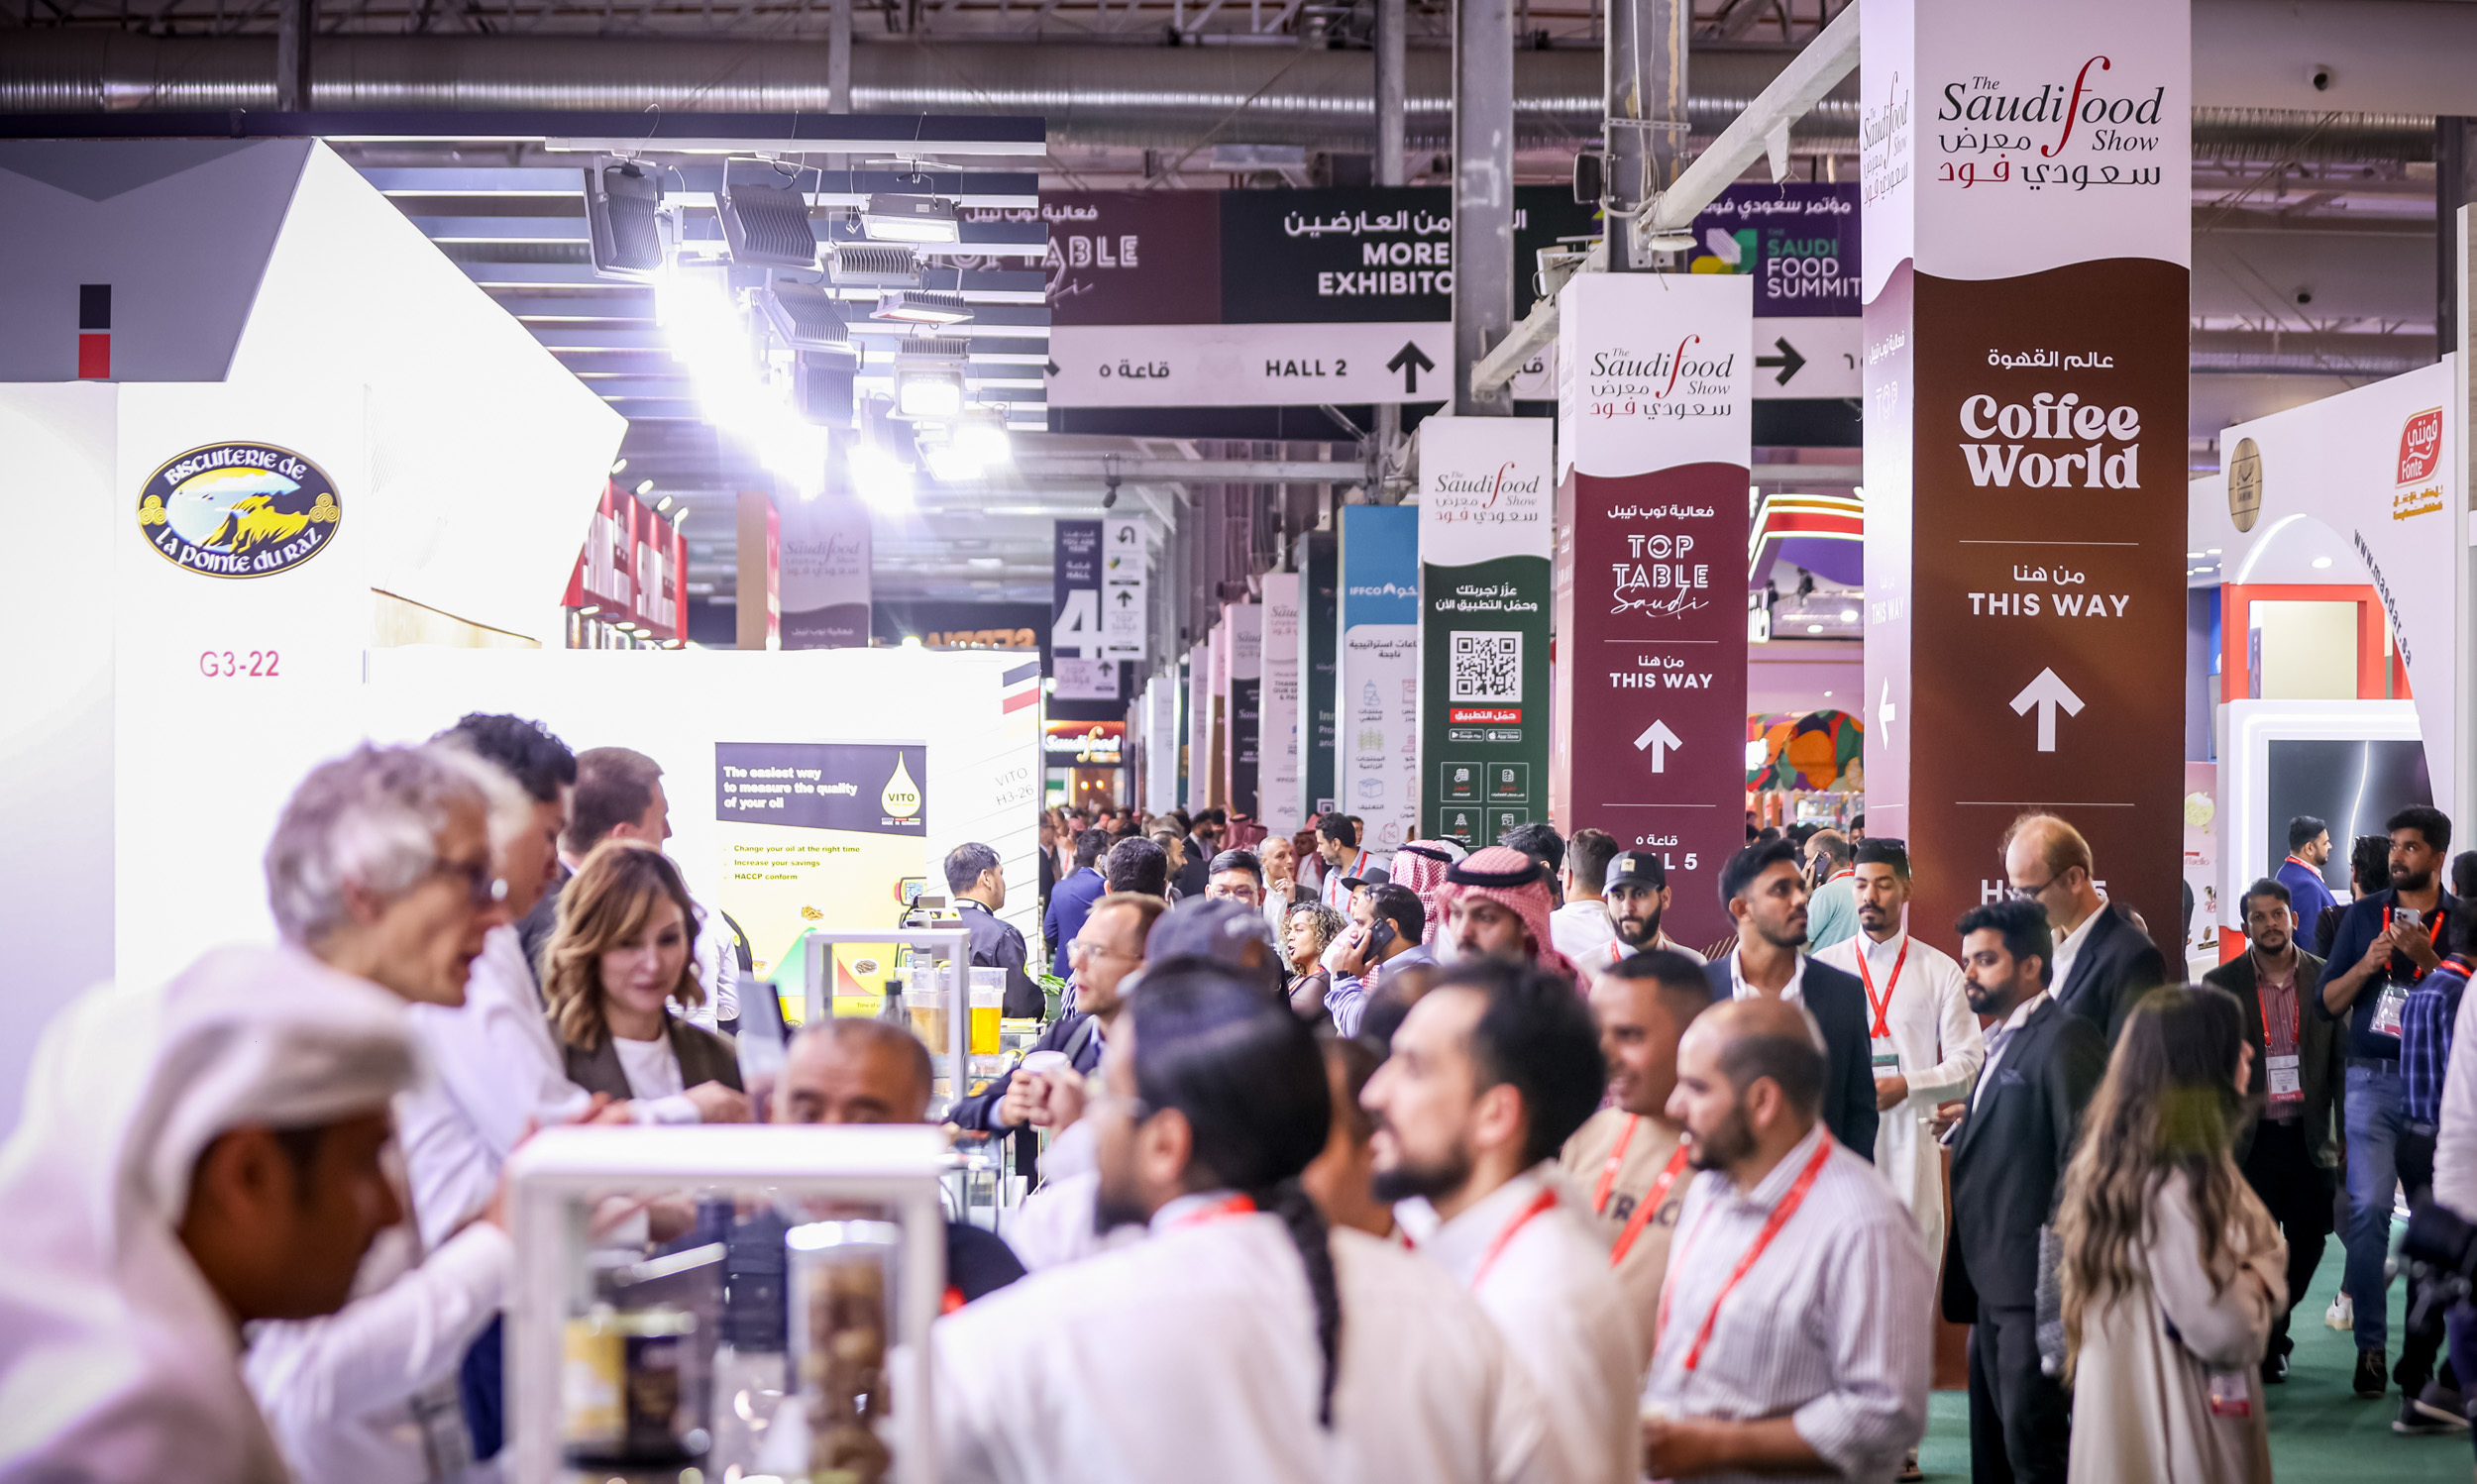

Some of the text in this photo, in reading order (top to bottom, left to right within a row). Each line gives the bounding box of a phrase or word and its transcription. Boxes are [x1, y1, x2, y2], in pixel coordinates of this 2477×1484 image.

[1973, 76, 2000, 91] The
[1938, 127, 2031, 155] معرض
[2092, 129, 2160, 152] Show
[1938, 153, 2161, 191] سعودي فود
[1042, 203, 1099, 223] فعالية
[1737, 200, 1802, 220] سعودي
[1804, 197, 1852, 216] مؤتمر
[1284, 209, 1453, 238] من العارضين
[1362, 242, 1451, 266] MORE
[1768, 238, 1838, 257] SAUDI
[1768, 257, 1840, 278] FOOD
[1318, 270, 1454, 296] EXHIBITO
[1767, 276, 1862, 298] SUMMIT
[1612, 348, 1630, 357] The
[1988, 349, 2114, 371] عالم القهوة
[1119, 360, 1170, 379] قاعة
[1266, 360, 1347, 377] HALL 2
[1590, 379, 1650, 397] معرض
[1687, 380, 1731, 395] Show
[1589, 396, 1731, 420] سعودي فود
[1959, 392, 2141, 441] Coffee
[2407, 412, 2438, 453] فونتي
[279, 456, 307, 481] de
[1959, 443, 2141, 489] World
[2402, 458, 2423, 480] Fonte
[1435, 494, 1478, 507] معرض
[1506, 495, 1537, 506] Show
[1435, 506, 1538, 524] سعودي فود
[1607, 504, 1715, 519] فعالية توب تيبل
[1627, 535, 1694, 559] TOP
[1612, 564, 1709, 588] TABLE
[2013, 564, 2086, 585] من هنا
[1349, 586, 1381, 595] IFFCO
[2354, 529, 2412, 668] www.masdar.sa
[1456, 599, 1501, 612] التطبيق
[1610, 583, 1709, 620] Saudi
[1872, 595, 1904, 625] THIS WAY
[1968, 592, 2129, 617] THIS WAY
[1051, 589, 1103, 660] 4
[200, 650, 279, 677] G3-22
[1638, 655, 1685, 669] من هنا
[1609, 673, 1713, 689] THIS WAY
[1454, 710, 1492, 721] التطبيق
[723, 766, 822, 781] The easiest way
[995, 767, 1027, 787] VITO
[723, 782, 858, 796] to measure the quality
[888, 794, 915, 802] VITO
[996, 785, 1034, 806] H3-26
[723, 796, 785, 810] of your oil
[1647, 834, 1678, 846] قاعة
[1684, 853, 1698, 871] 5
